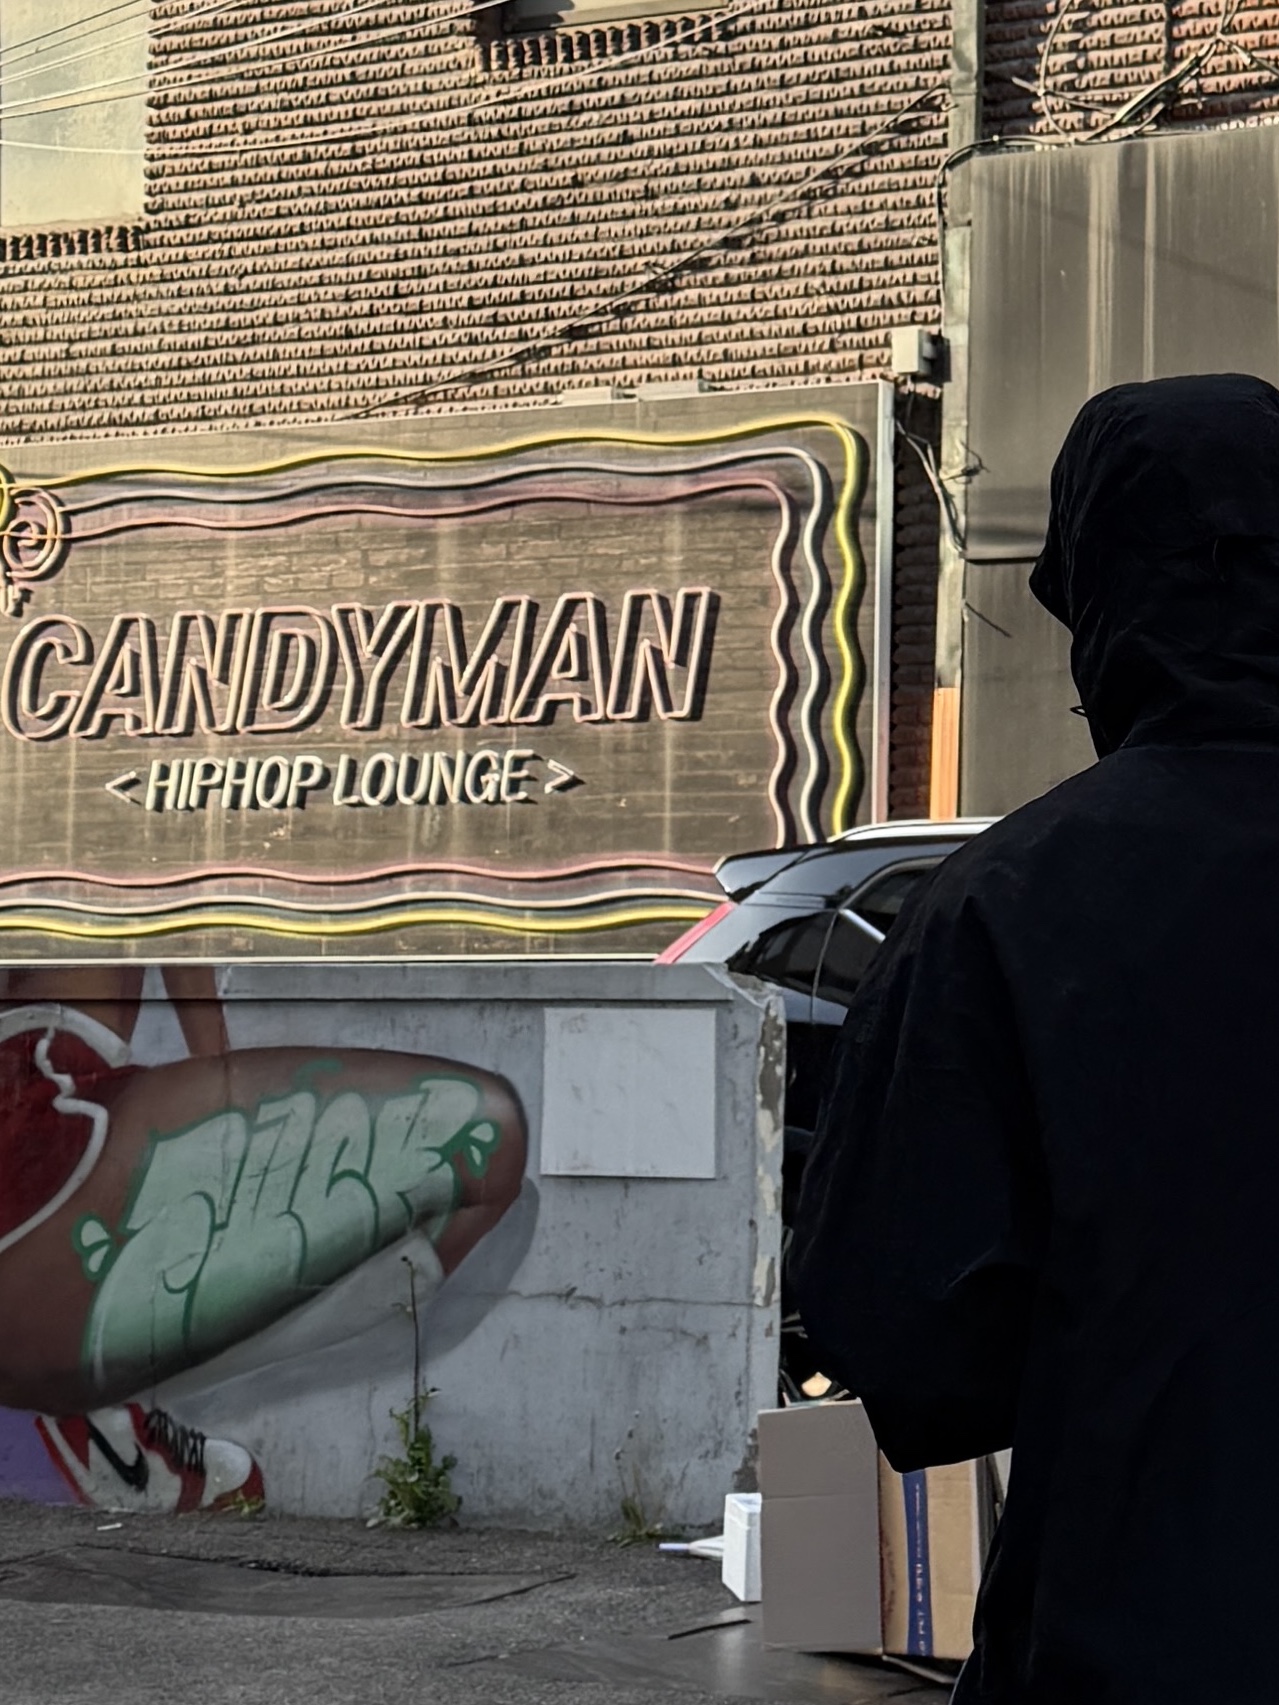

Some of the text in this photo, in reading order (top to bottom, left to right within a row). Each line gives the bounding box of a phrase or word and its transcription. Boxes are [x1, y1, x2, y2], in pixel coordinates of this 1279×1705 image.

[2, 586, 716, 742] CANDYMAN
[146, 749, 536, 811] HIPHOP LOUNGE
